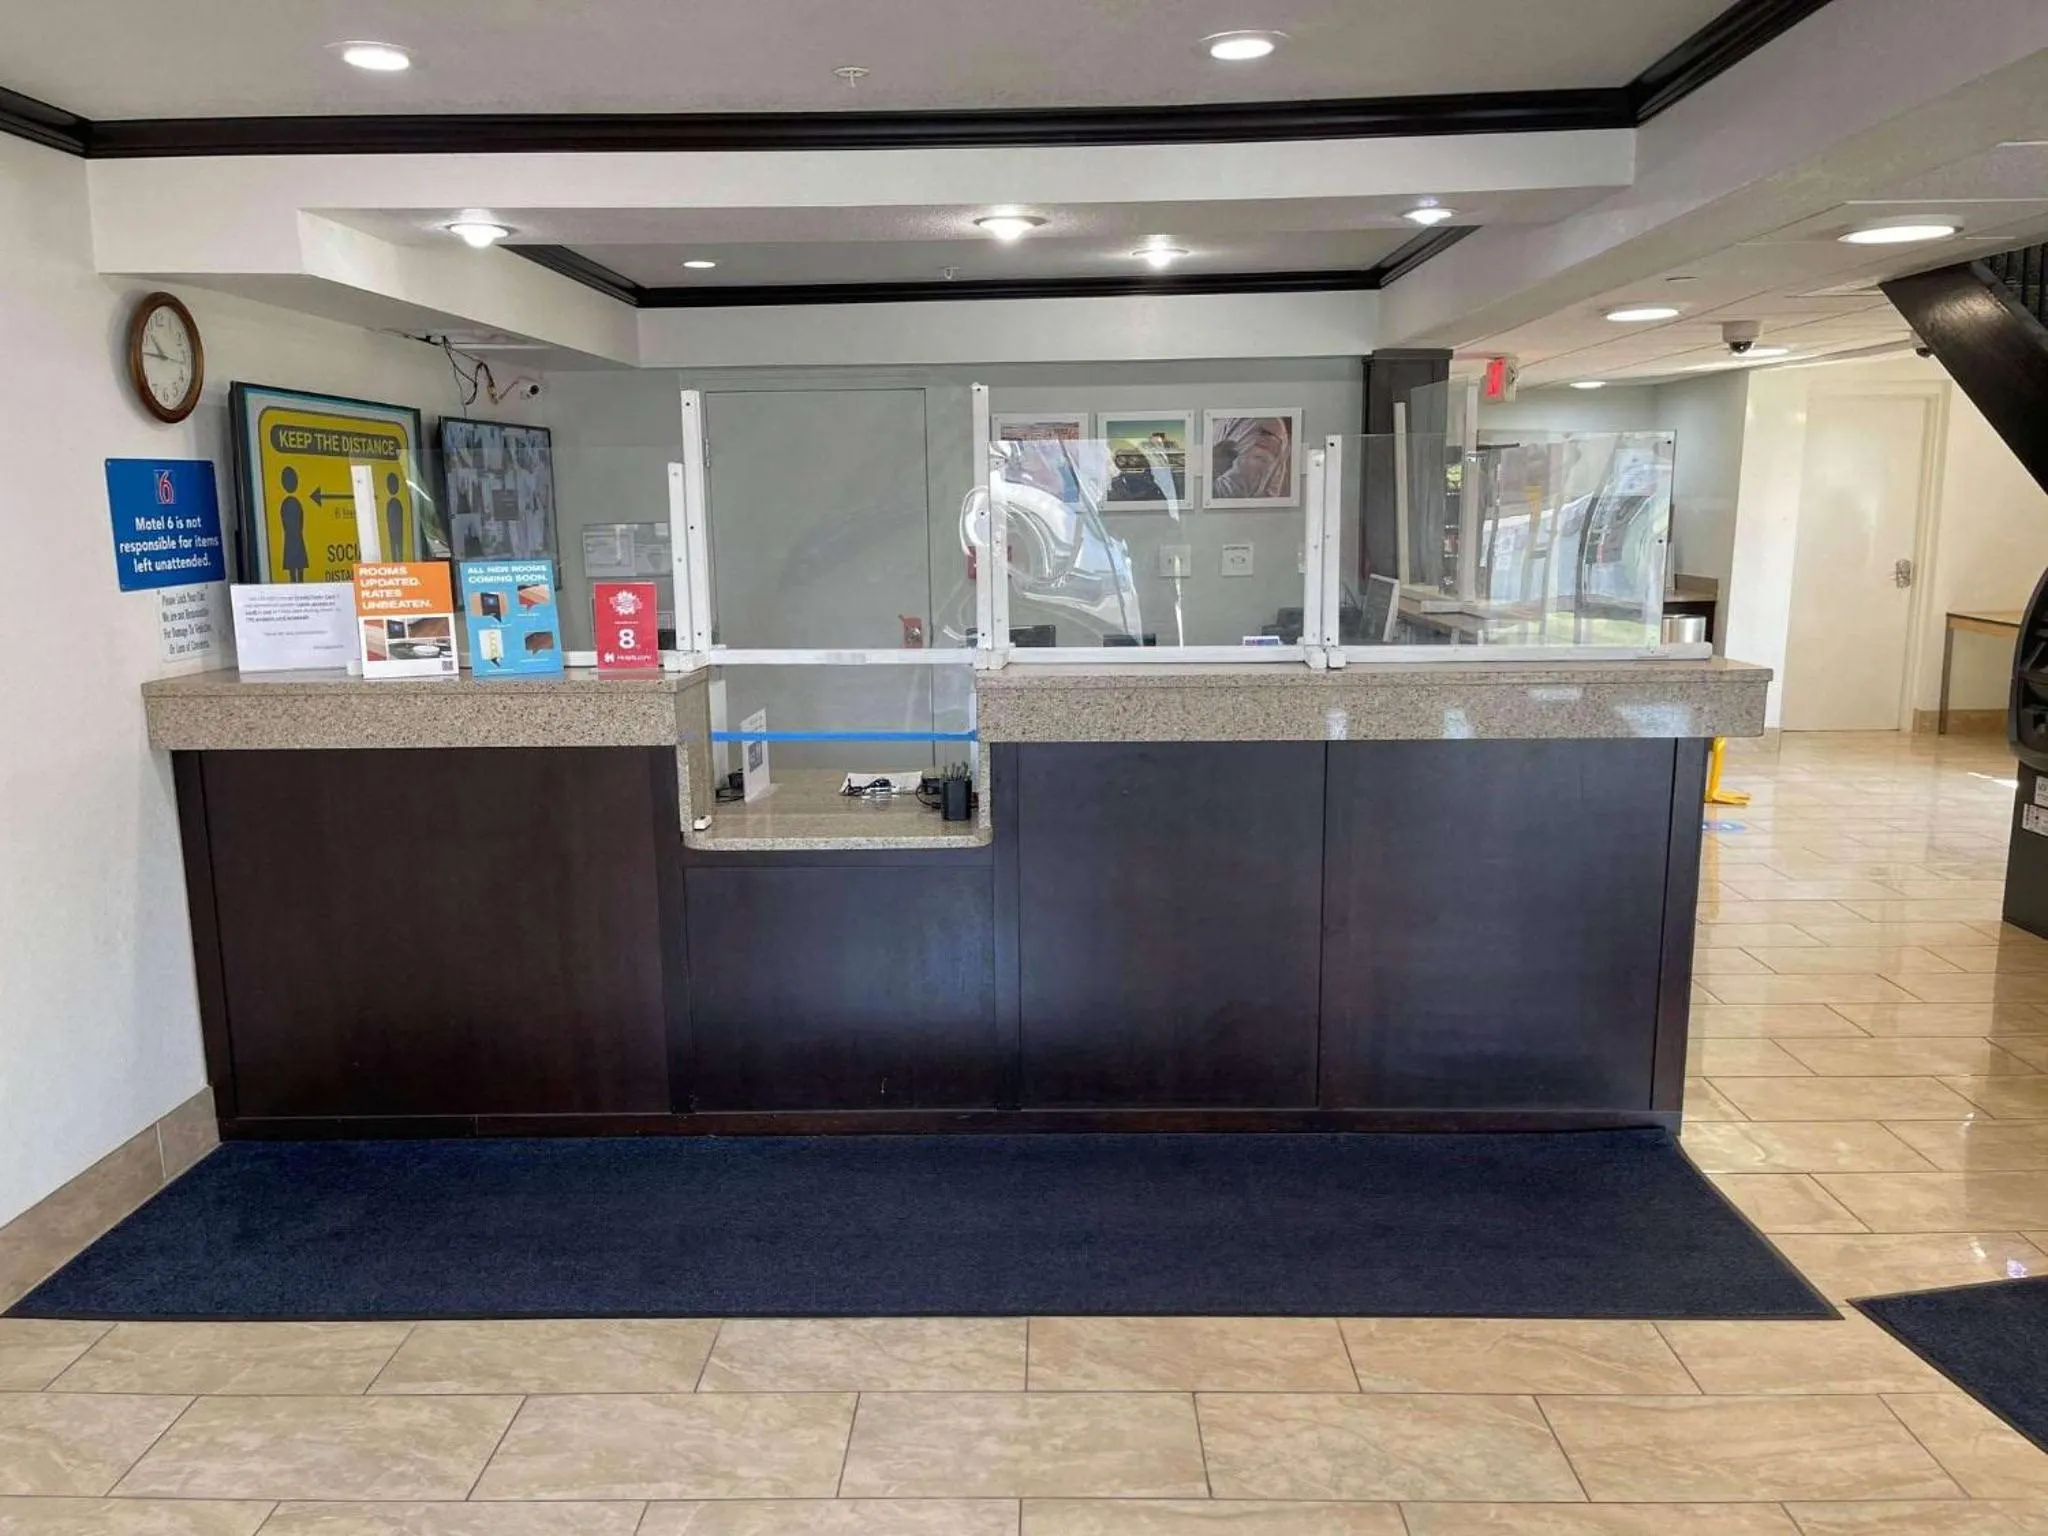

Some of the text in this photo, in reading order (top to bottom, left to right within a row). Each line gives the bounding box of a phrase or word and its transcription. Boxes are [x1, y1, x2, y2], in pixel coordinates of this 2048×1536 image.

[279, 430, 395, 456] KEEP THE DISTANCE
[158, 469, 175, 504] 6
[135, 515, 202, 531] Motel 6 is not
[120, 535, 219, 555] responsible for items
[133, 553, 211, 573] left unattended.
[359, 567, 408, 576] ROOMS
[468, 567, 485, 575] ALL
[511, 565, 548, 573] ROOMS
[360, 577, 421, 587] UPDATED.
[468, 574, 513, 584] COMING
[361, 589, 402, 598] RATES
[362, 600, 432, 610] UNBEATEN.
[619, 628, 635, 649] 8
